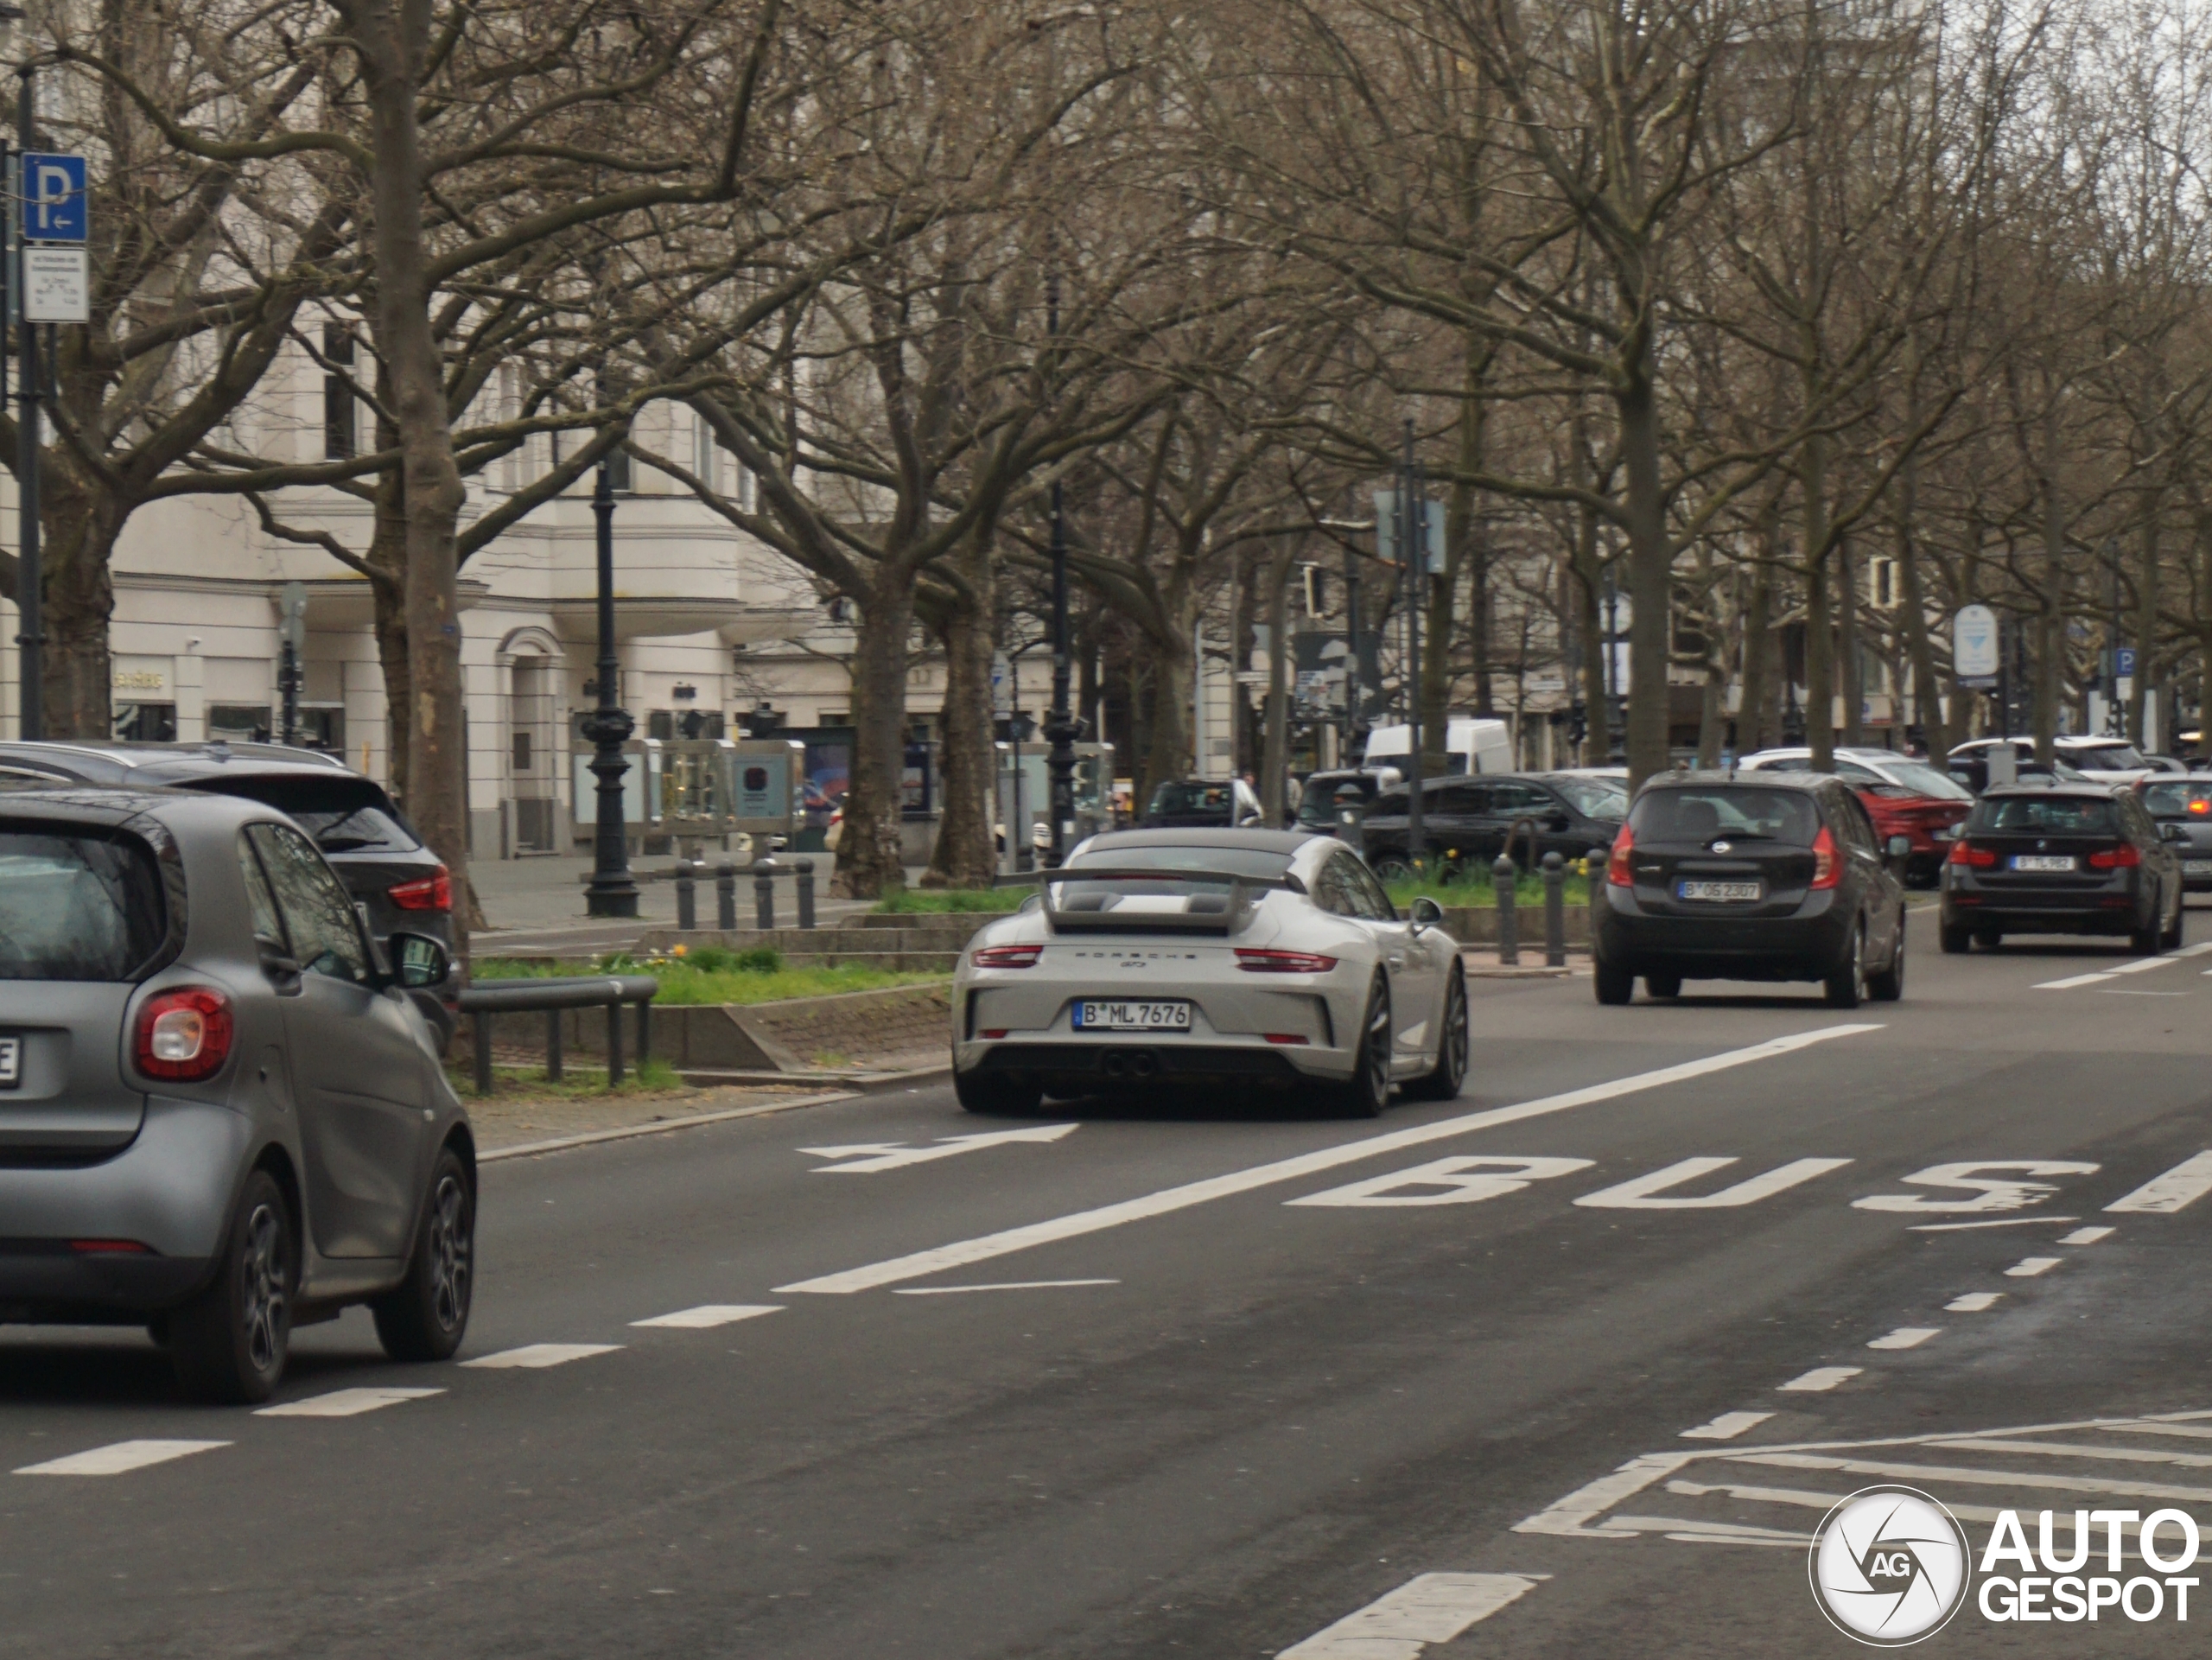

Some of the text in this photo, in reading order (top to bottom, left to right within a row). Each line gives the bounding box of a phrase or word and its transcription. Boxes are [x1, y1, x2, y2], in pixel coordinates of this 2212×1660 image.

[38, 165, 73, 229] P
[1084, 1005, 1186, 1024] B ML 7676
[1281, 1155, 2102, 1212] BUS
